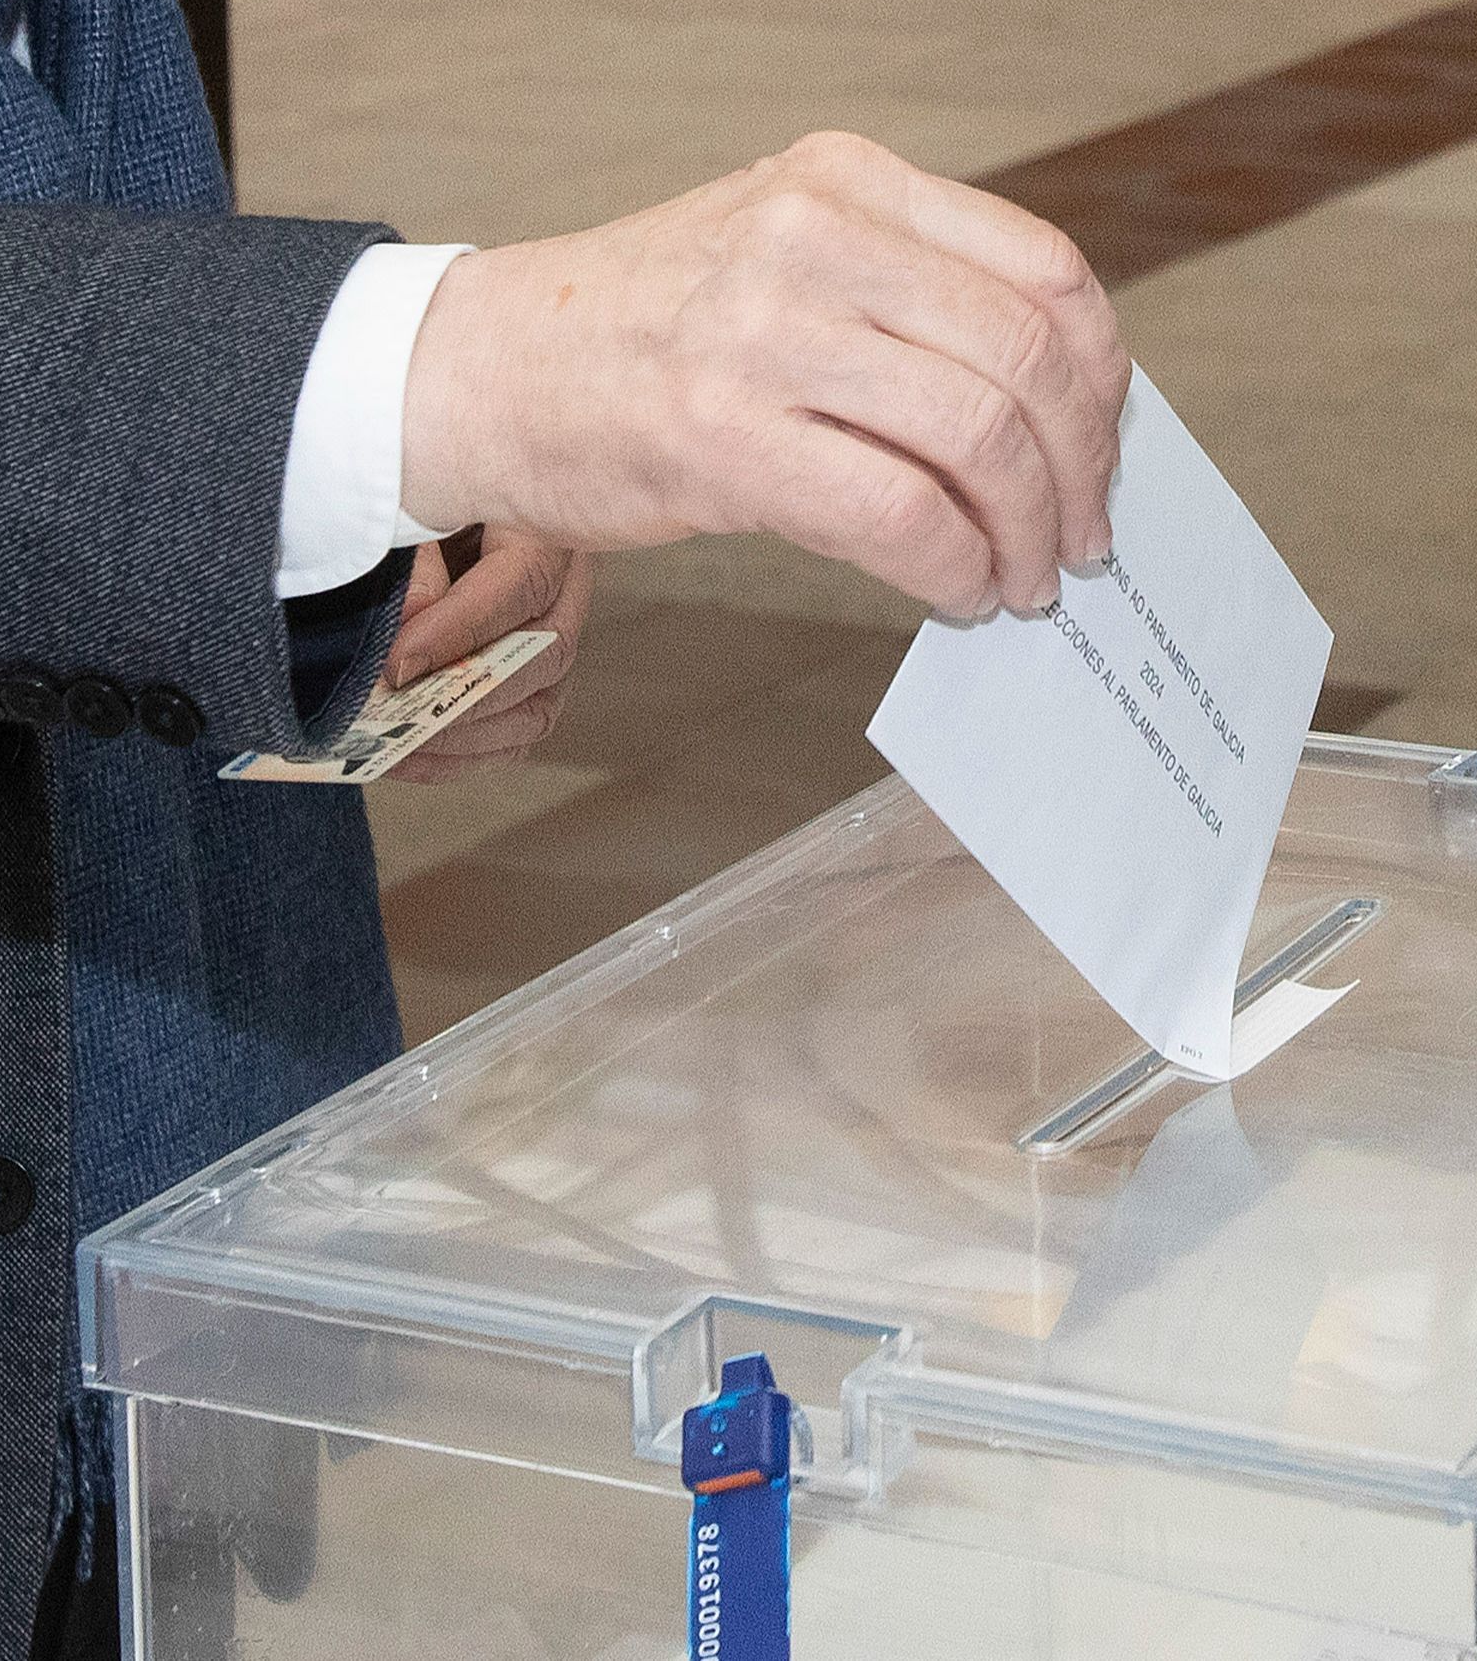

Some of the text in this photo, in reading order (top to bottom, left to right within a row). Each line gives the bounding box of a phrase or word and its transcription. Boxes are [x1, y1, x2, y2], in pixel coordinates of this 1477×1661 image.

[1101, 668, 1117, 694] AL
[1114, 684, 1177, 773] PARLAMENTO
[1173, 765, 1191, 793] DE
[1186, 787, 1223, 839] GALICIA
[1128, 588, 1147, 616] AO
[1144, 608, 1202, 697] PARLAMENTO
[1199, 689, 1214, 719] DE
[1212, 710, 1245, 765] GALICIA
[1139, 660, 1166, 701] 2024
[696, 1523, 721, 1661] 00019378
